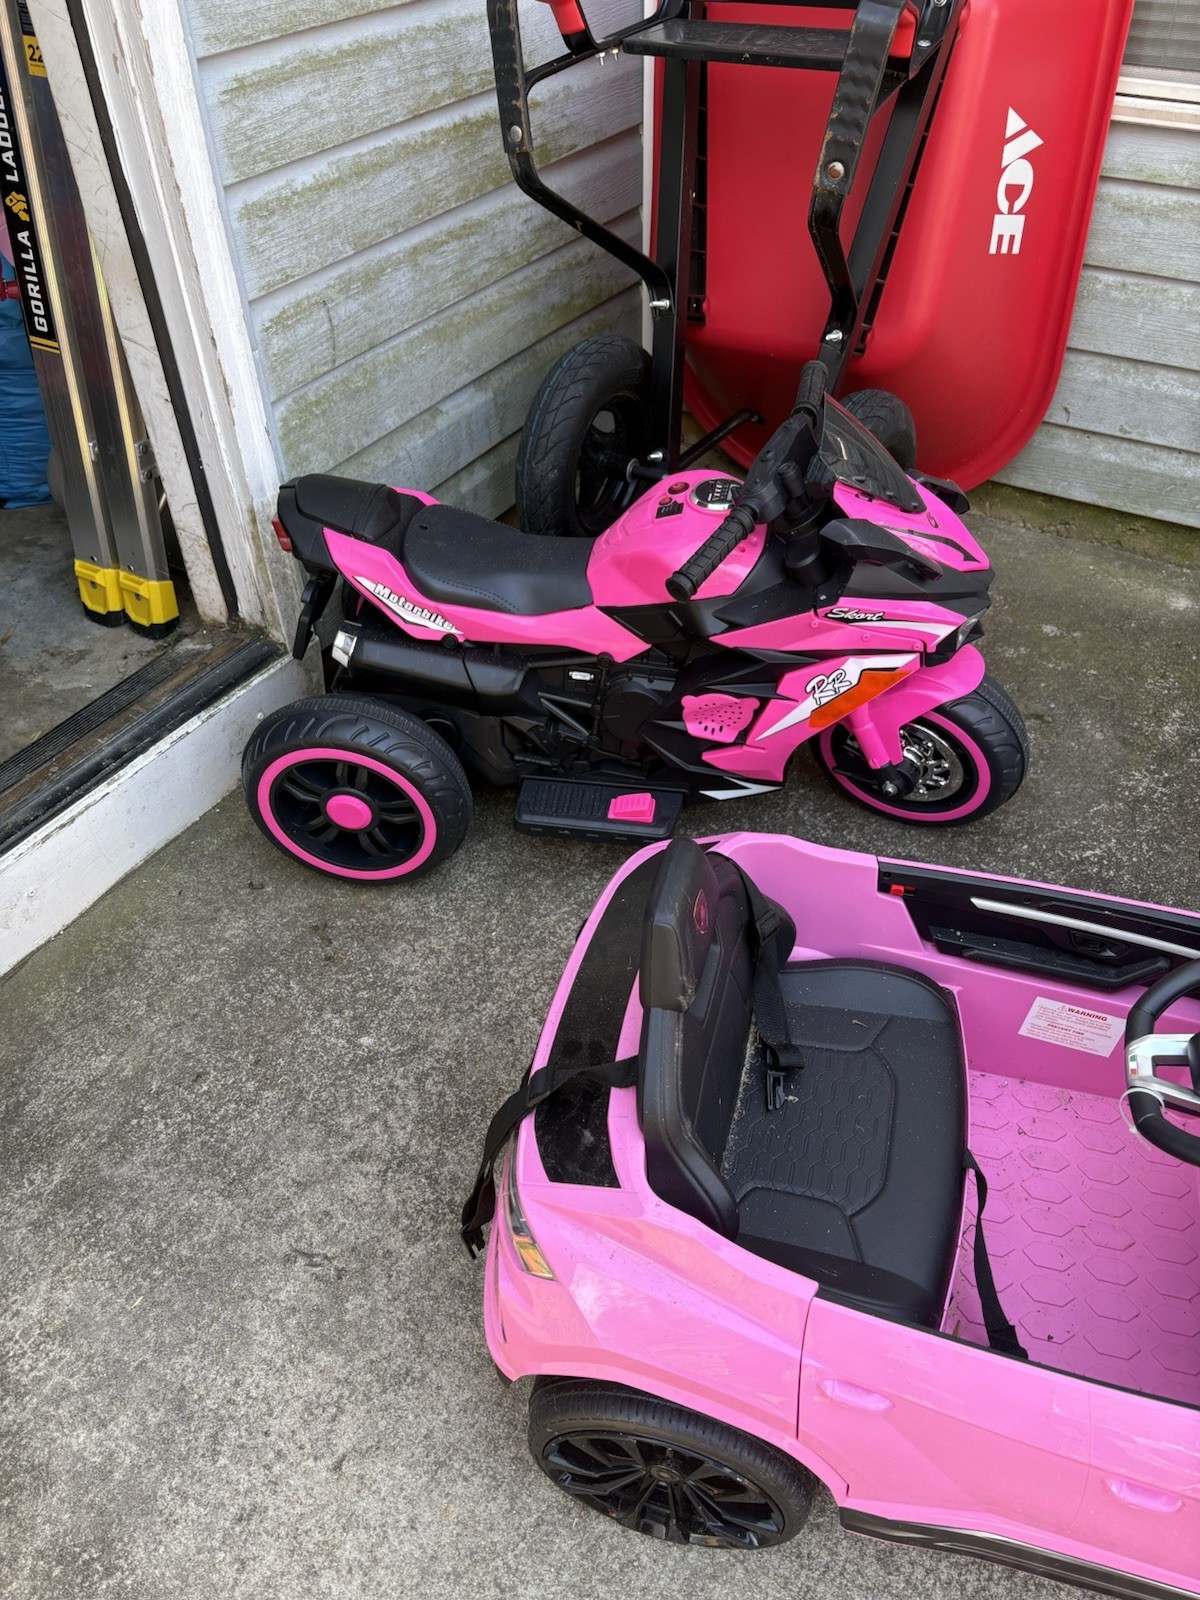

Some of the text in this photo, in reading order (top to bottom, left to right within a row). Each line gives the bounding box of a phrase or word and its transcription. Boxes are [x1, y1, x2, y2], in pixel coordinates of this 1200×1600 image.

[989, 106, 1044, 254] ACE
[0, 86, 49, 333] GORILLA LADD
[374, 582, 456, 631] Motorbike
[805, 669, 852, 705] RR
[1067, 1007, 1108, 1021] WARNING
